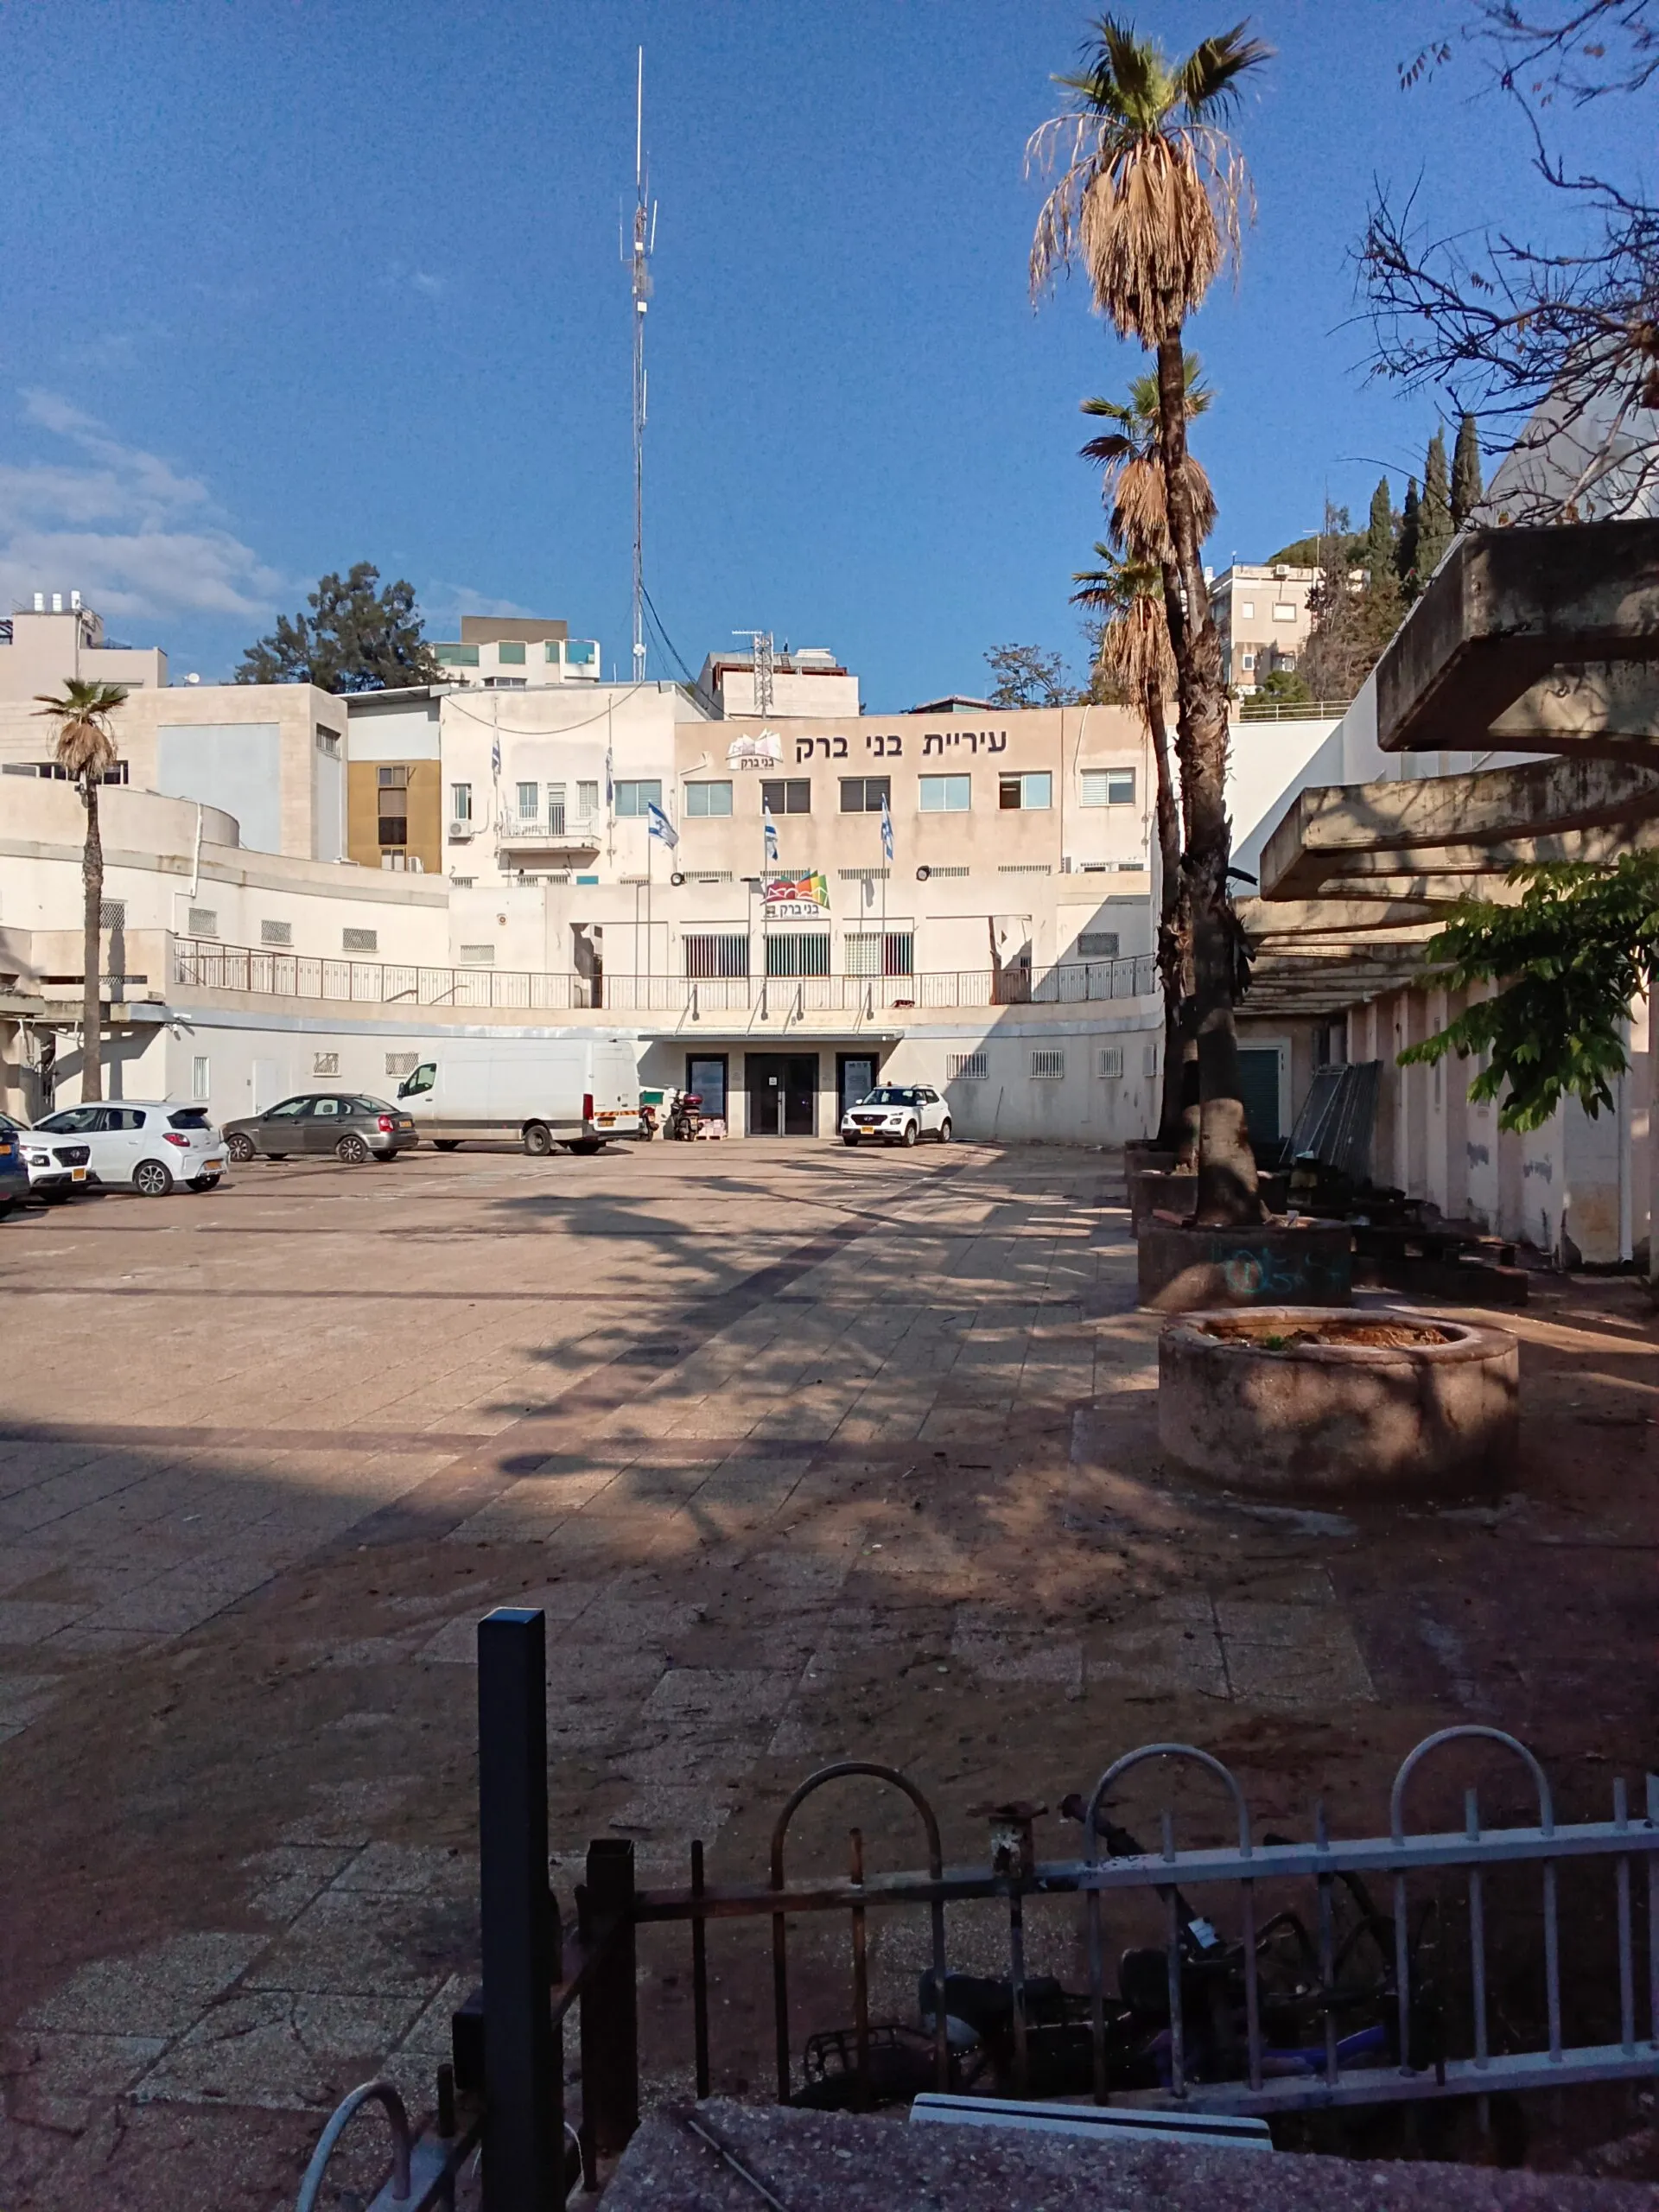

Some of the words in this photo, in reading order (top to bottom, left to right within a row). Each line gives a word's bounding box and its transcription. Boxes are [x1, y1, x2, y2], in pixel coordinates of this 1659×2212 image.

[866, 734, 903, 757] בני
[922, 731, 1007, 755] עיריית
[795, 737, 849, 764] ברק
[741, 758, 760, 771] ברק
[761, 758, 774, 767] בני
[780, 905, 802, 918] ברק
[804, 904, 819, 914] בני
